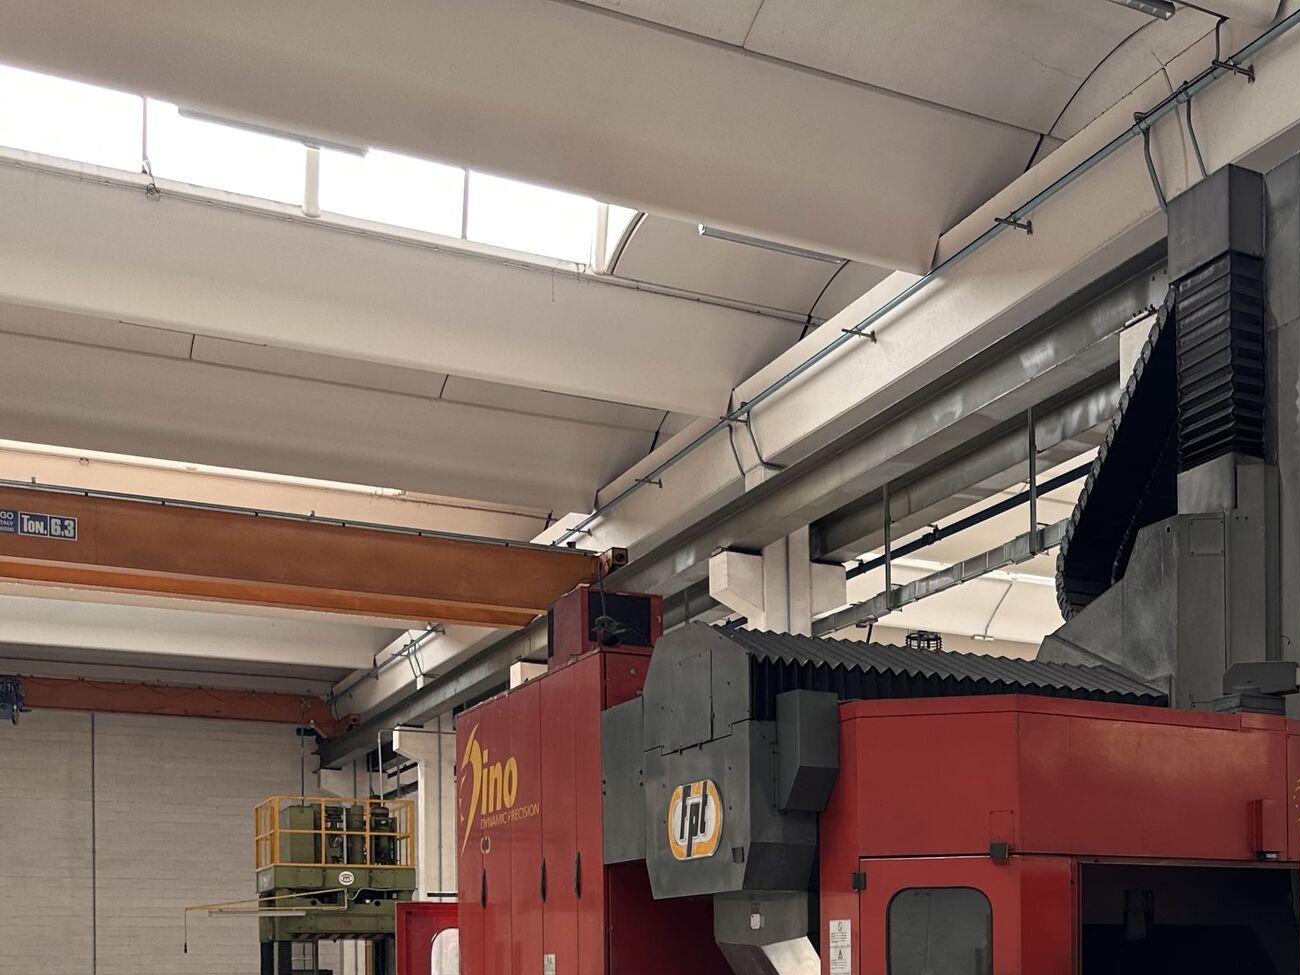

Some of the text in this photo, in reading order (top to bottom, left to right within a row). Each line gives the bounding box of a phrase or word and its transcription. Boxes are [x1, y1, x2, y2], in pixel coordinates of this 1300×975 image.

[51, 518, 75, 537] 6.3
[481, 802, 540, 830] DYNAMIC PRECISION
